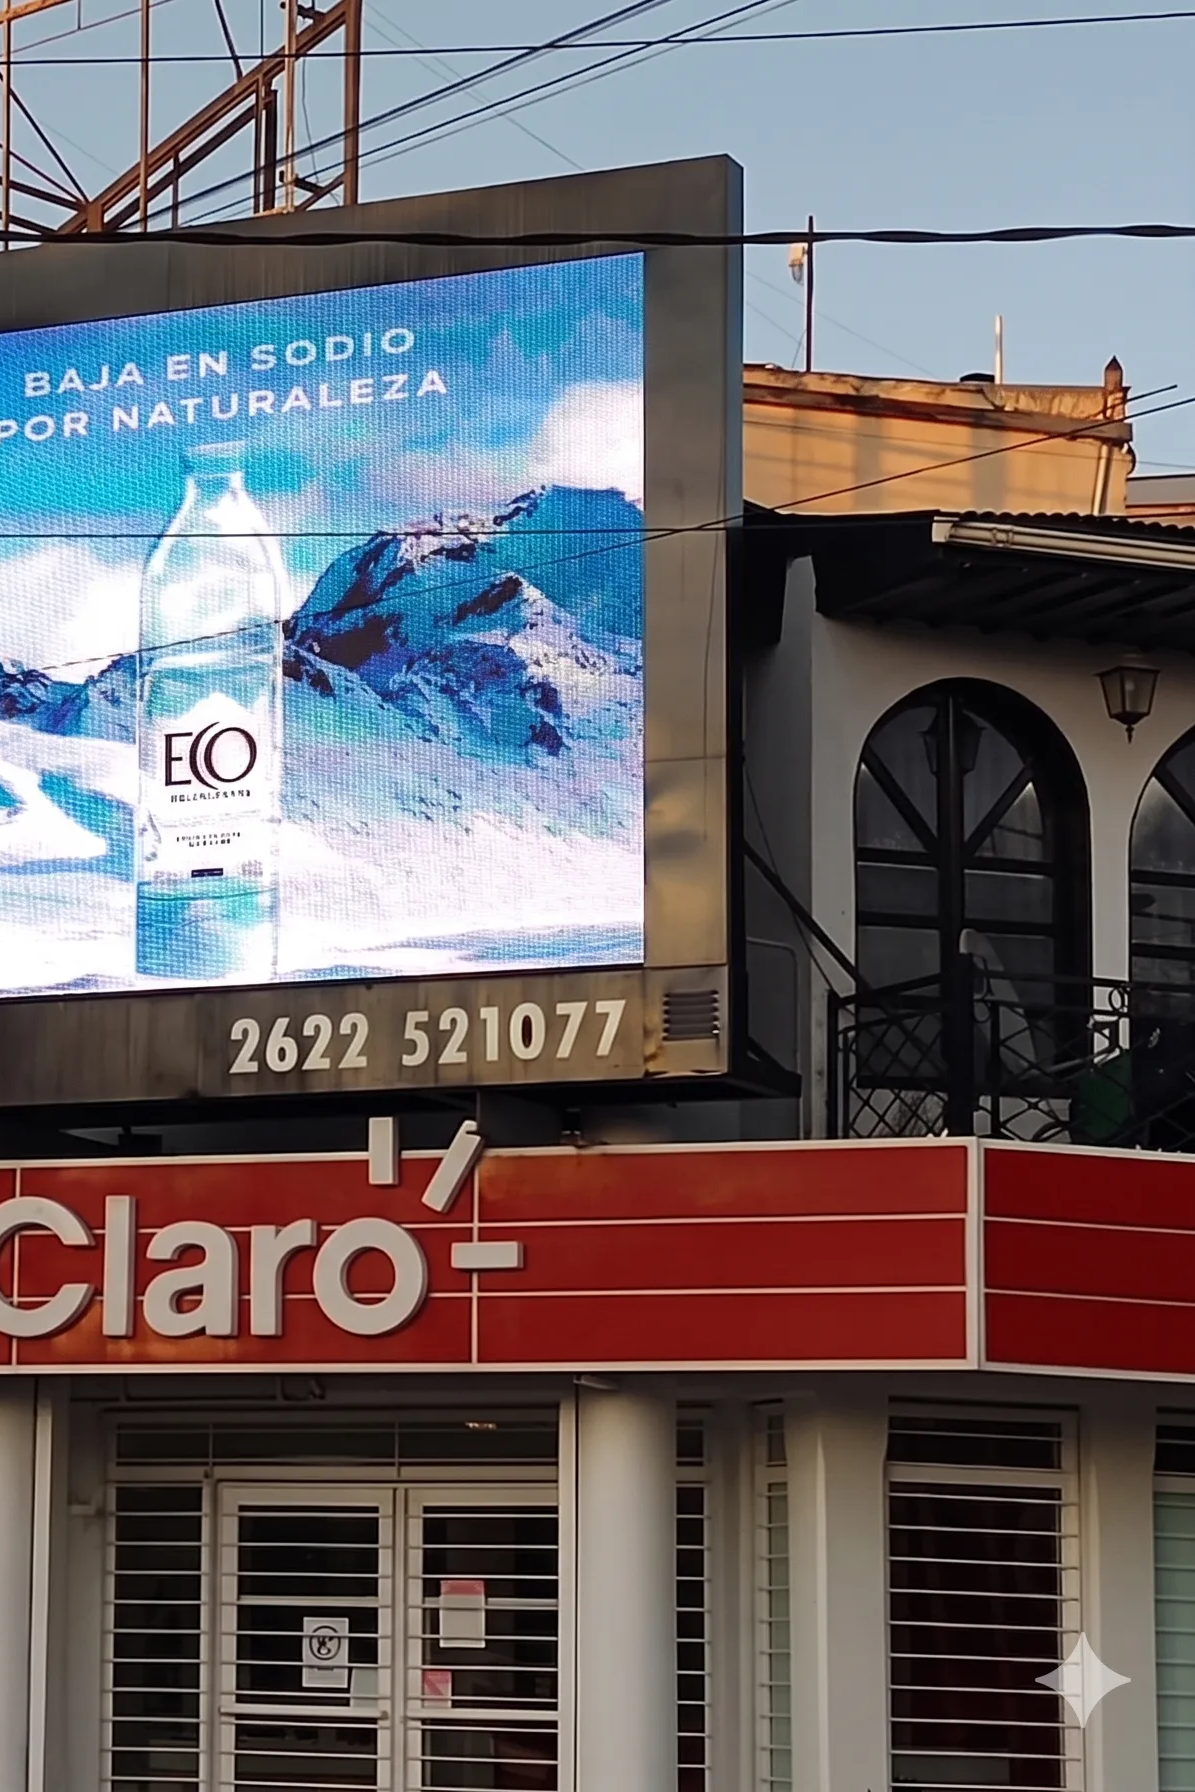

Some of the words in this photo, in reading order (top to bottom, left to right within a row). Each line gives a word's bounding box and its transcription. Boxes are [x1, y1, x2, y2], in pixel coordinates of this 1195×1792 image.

[23, 363, 144, 398] BAJA
[166, 349, 227, 381] EN
[251, 327, 416, 372] SODIO
[111, 369, 447, 432] NATURALEZA
[164, 722, 258, 790] ECO
[229, 1013, 368, 1074] 2622
[402, 1000, 626, 1067] 521077
